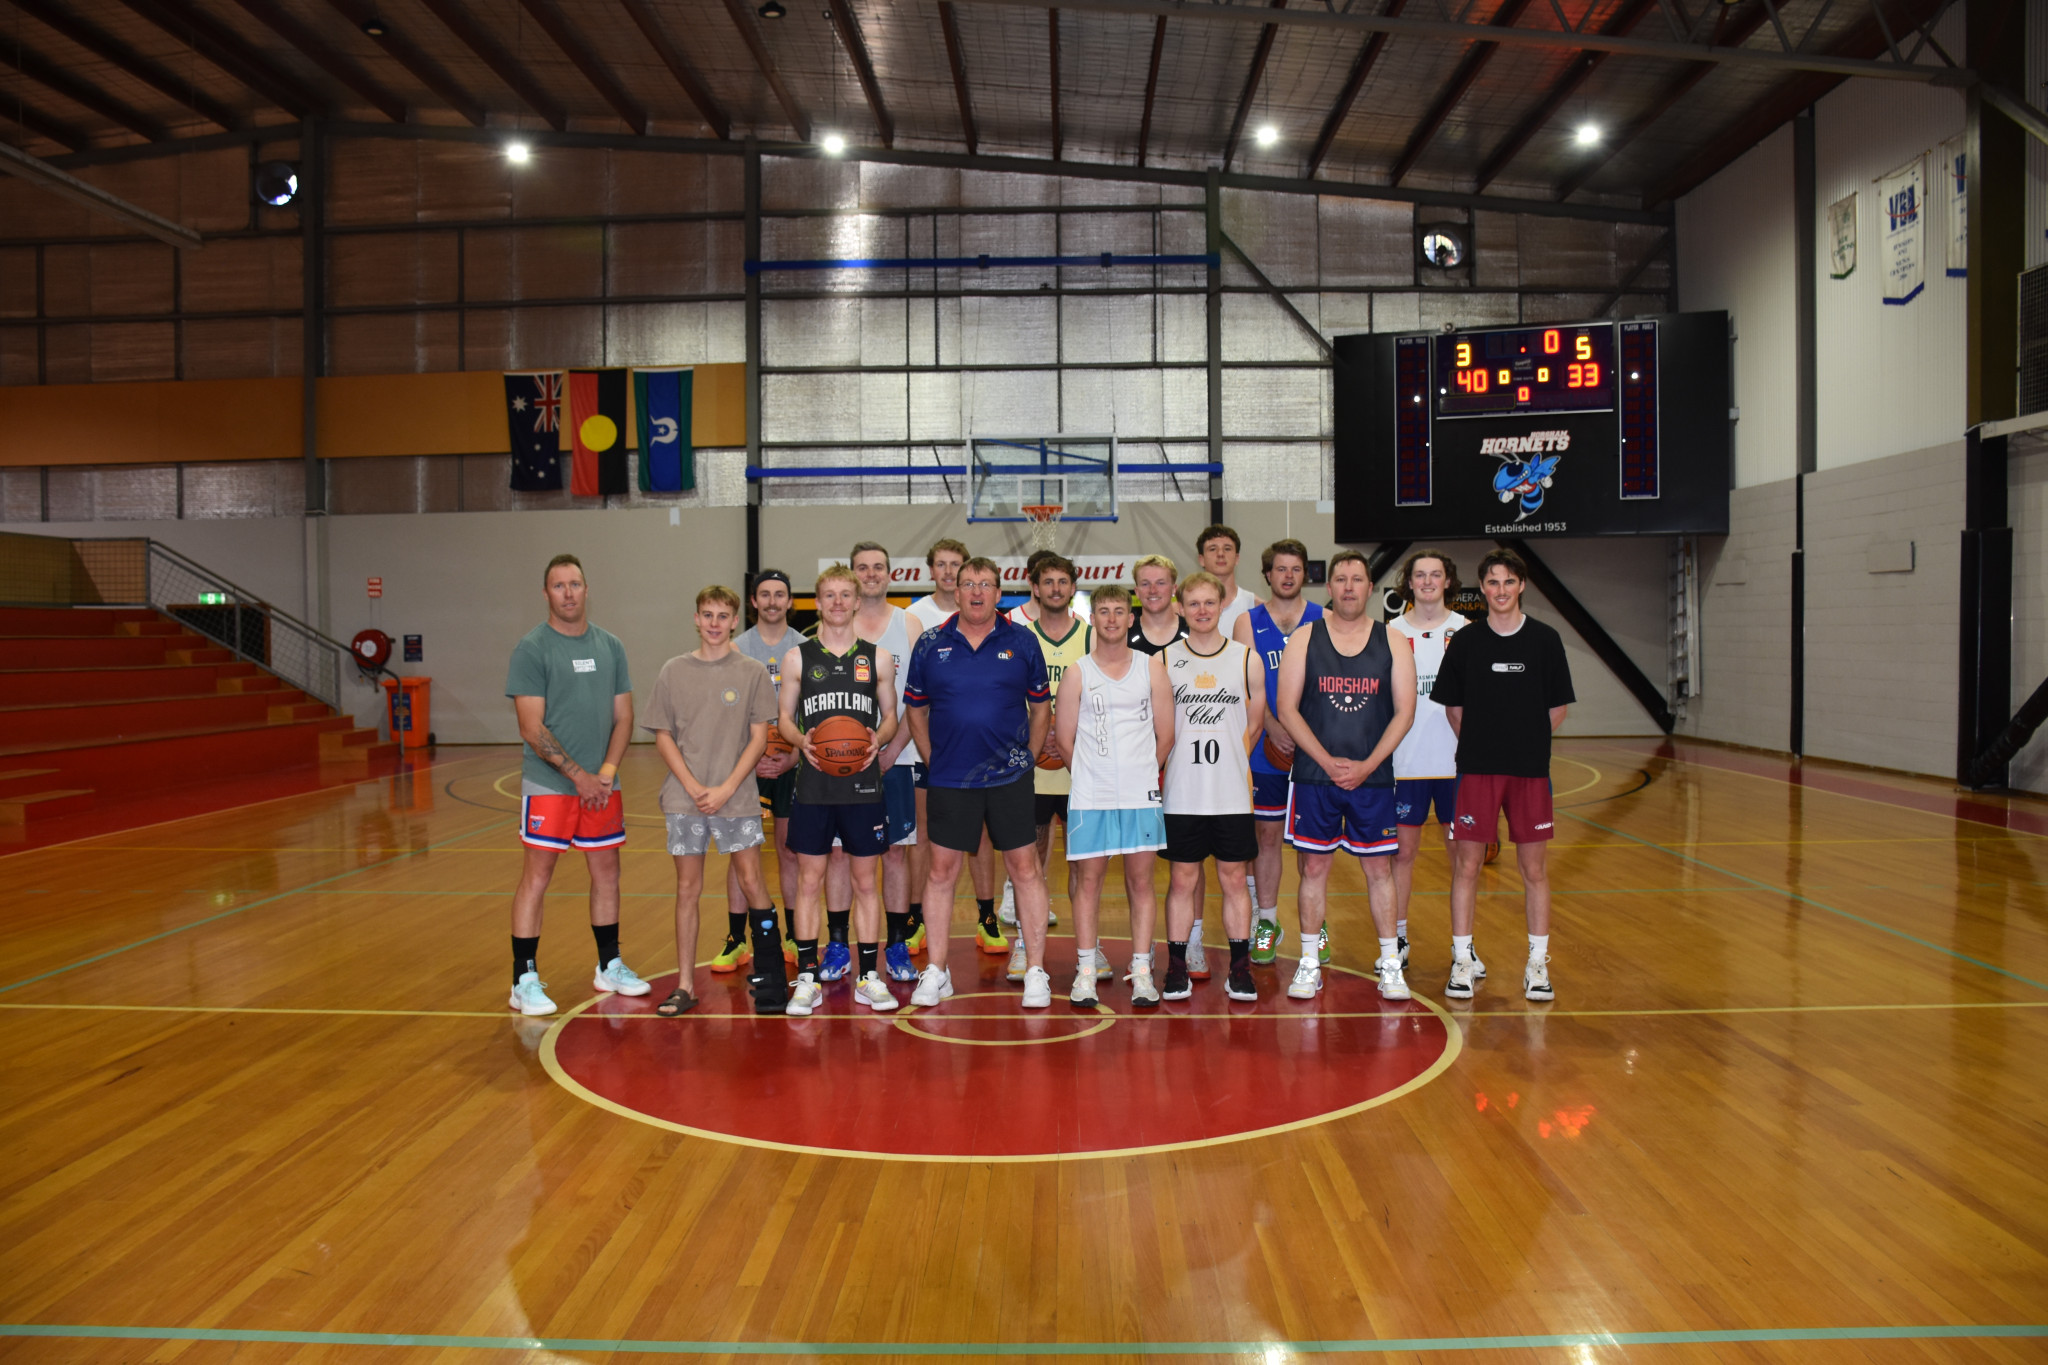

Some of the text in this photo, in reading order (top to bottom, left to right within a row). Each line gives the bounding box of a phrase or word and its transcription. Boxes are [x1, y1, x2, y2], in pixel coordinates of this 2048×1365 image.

[1544, 329, 1560, 354] 0
[1456, 343, 1471, 367] 3
[1457, 369, 1488, 393] 40
[1498, 369, 1510, 385] 0
[1537, 367, 1549, 383] 0
[1567, 362, 1599, 388] 33
[1518, 386, 1530, 402] 0
[1480, 437, 1570, 454] HORNETS
[1485, 522, 1567, 533] Established 1953
[1173, 684, 1240, 705] Canadian
[1318, 676, 1379, 694] HORSHAM
[804, 691, 873, 717] HEARTLAND
[1140, 697, 1149, 722] 3
[1329, 695, 1368, 712] BASKETBALL
[1186, 704, 1226, 725] Club
[825, 745, 866, 758] SPALDING
[1190, 739, 1220, 765] 10
